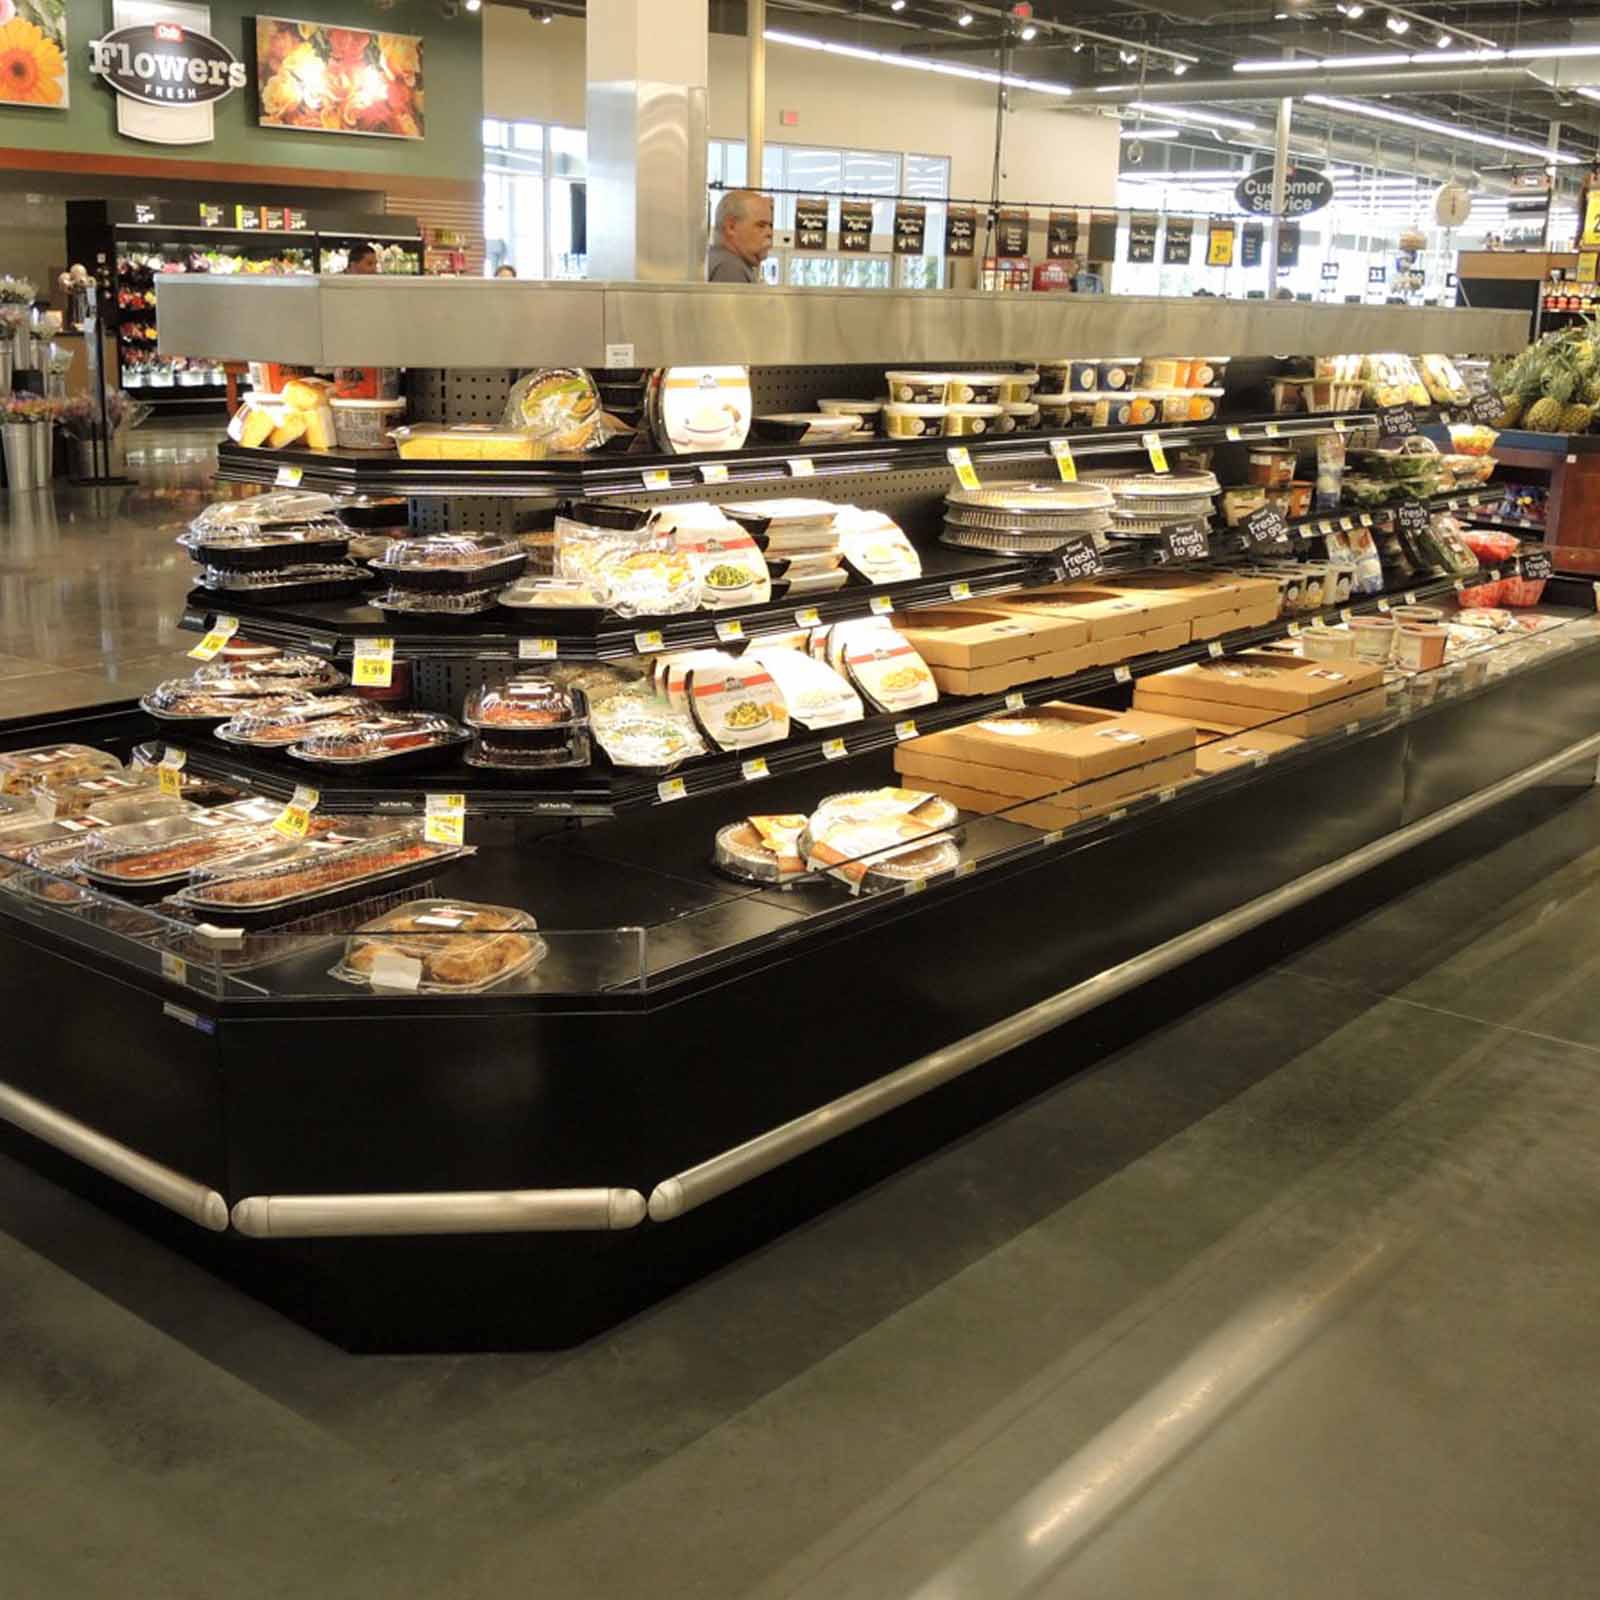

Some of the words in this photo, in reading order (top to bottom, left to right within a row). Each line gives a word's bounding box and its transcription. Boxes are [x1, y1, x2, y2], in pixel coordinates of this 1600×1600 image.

[88, 40, 247, 88] Flowers
[144, 84, 197, 99] FRESH
[1244, 179, 1324, 195] Cusomer
[1252, 195, 1313, 211] Sevice
[1248, 512, 1281, 535] Fresh
[1255, 531, 1268, 541] to
[1268, 523, 1282, 537] go
[1170, 529, 1204, 547] Fresh
[1062, 546, 1096, 569] Fresh
[1173, 546, 1185, 557] to
[1187, 544, 1202, 558] go
[1069, 566, 1081, 578] to
[1081, 560, 1097, 577] go
